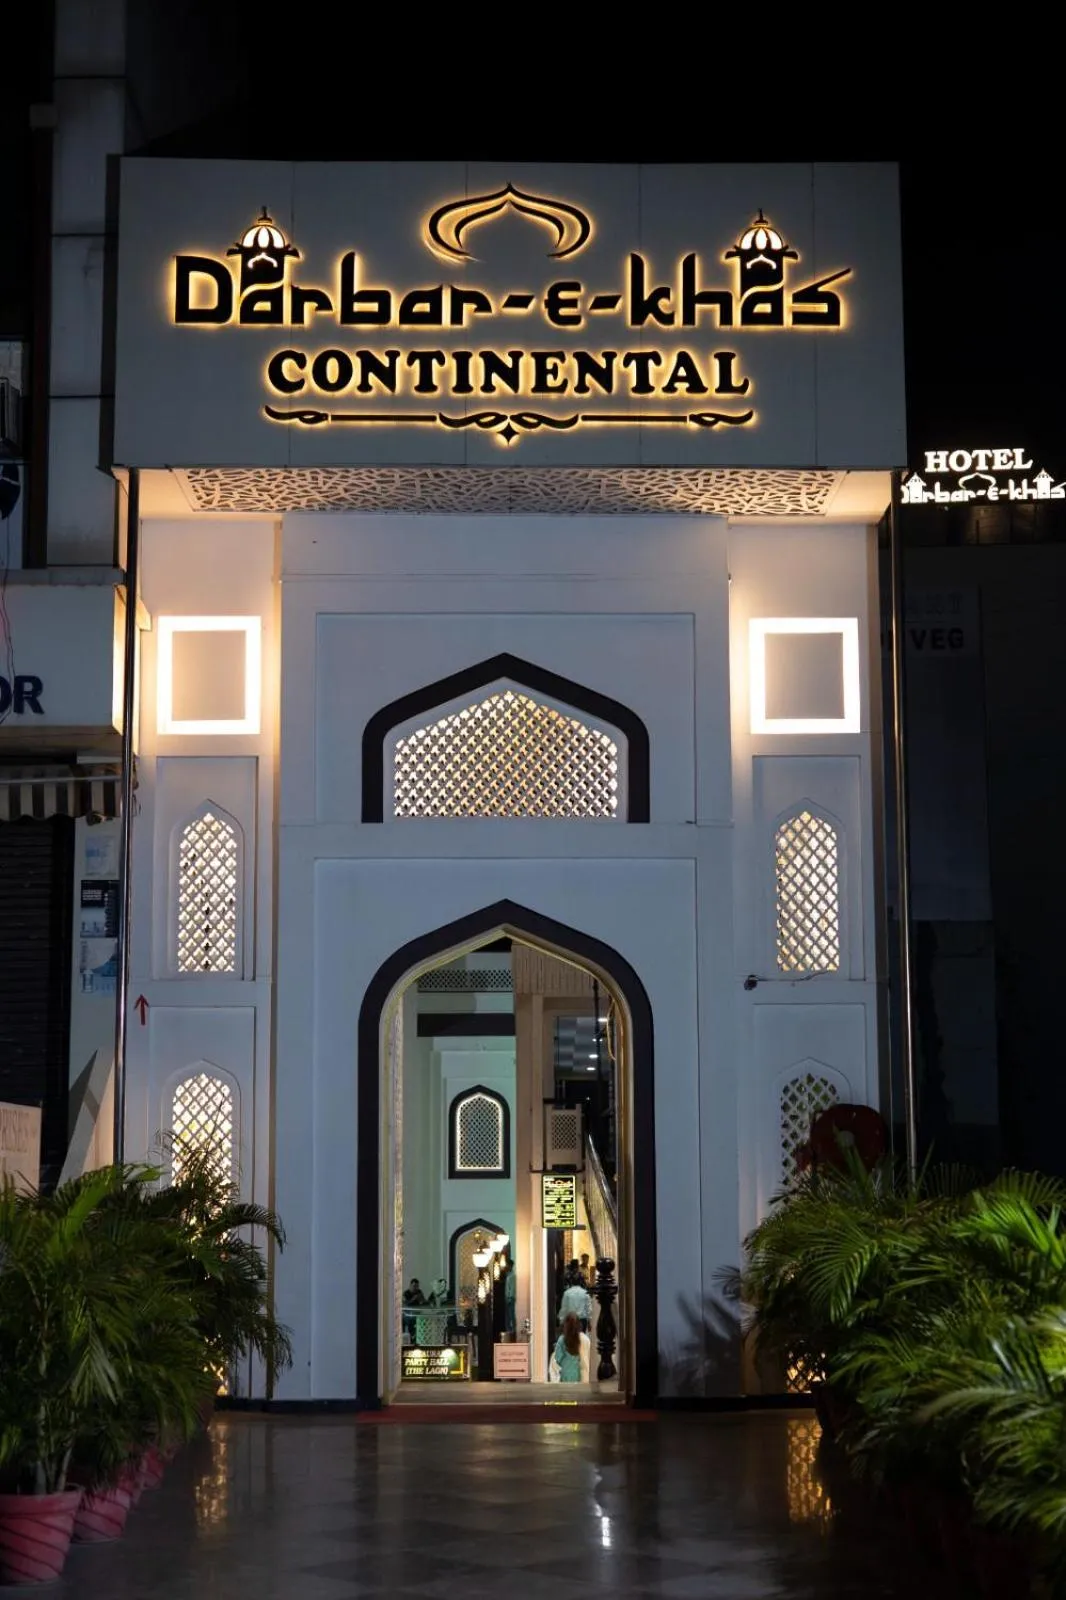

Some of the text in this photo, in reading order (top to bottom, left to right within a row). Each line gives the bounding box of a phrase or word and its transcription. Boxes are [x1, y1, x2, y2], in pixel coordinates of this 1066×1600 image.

[267, 349, 751, 397] CONTINENTAL
[924, 448, 1033, 472] HOTEL
[909, 628, 963, 651] VEG
[405, 1358, 450, 1366] PARTY HALL
